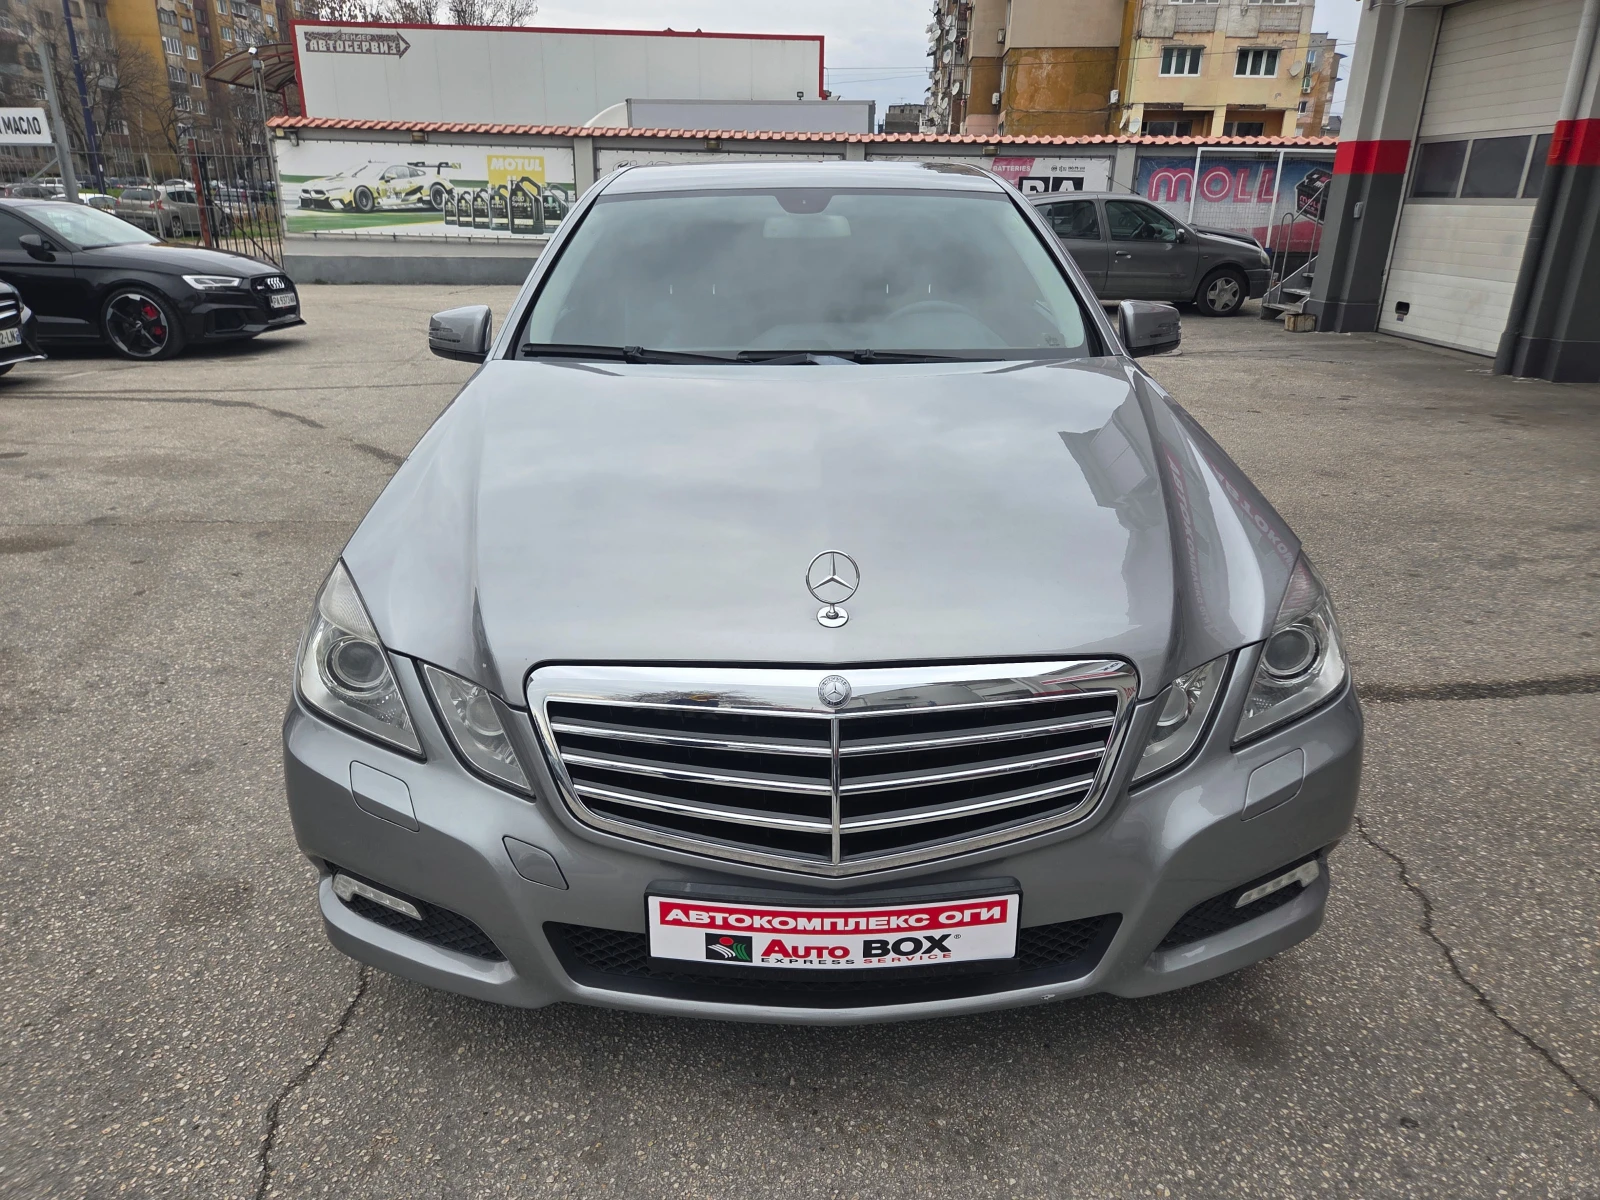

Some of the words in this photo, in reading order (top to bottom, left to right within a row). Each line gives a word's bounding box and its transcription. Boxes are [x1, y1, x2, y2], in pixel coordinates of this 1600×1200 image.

[309, 40, 397, 54] АВТОСЕРВИЗ
[1, 116, 41, 135] МАСЛО
[490, 157, 542, 171] MOTUL
[1147, 166, 1281, 203] MOLL
[664, 908, 930, 931] АВТОКОМПЛЕКС
[938, 906, 1001, 924] ОГИ
[761, 957, 854, 965] EXPRESS
[863, 952, 952, 964] SERVICE
